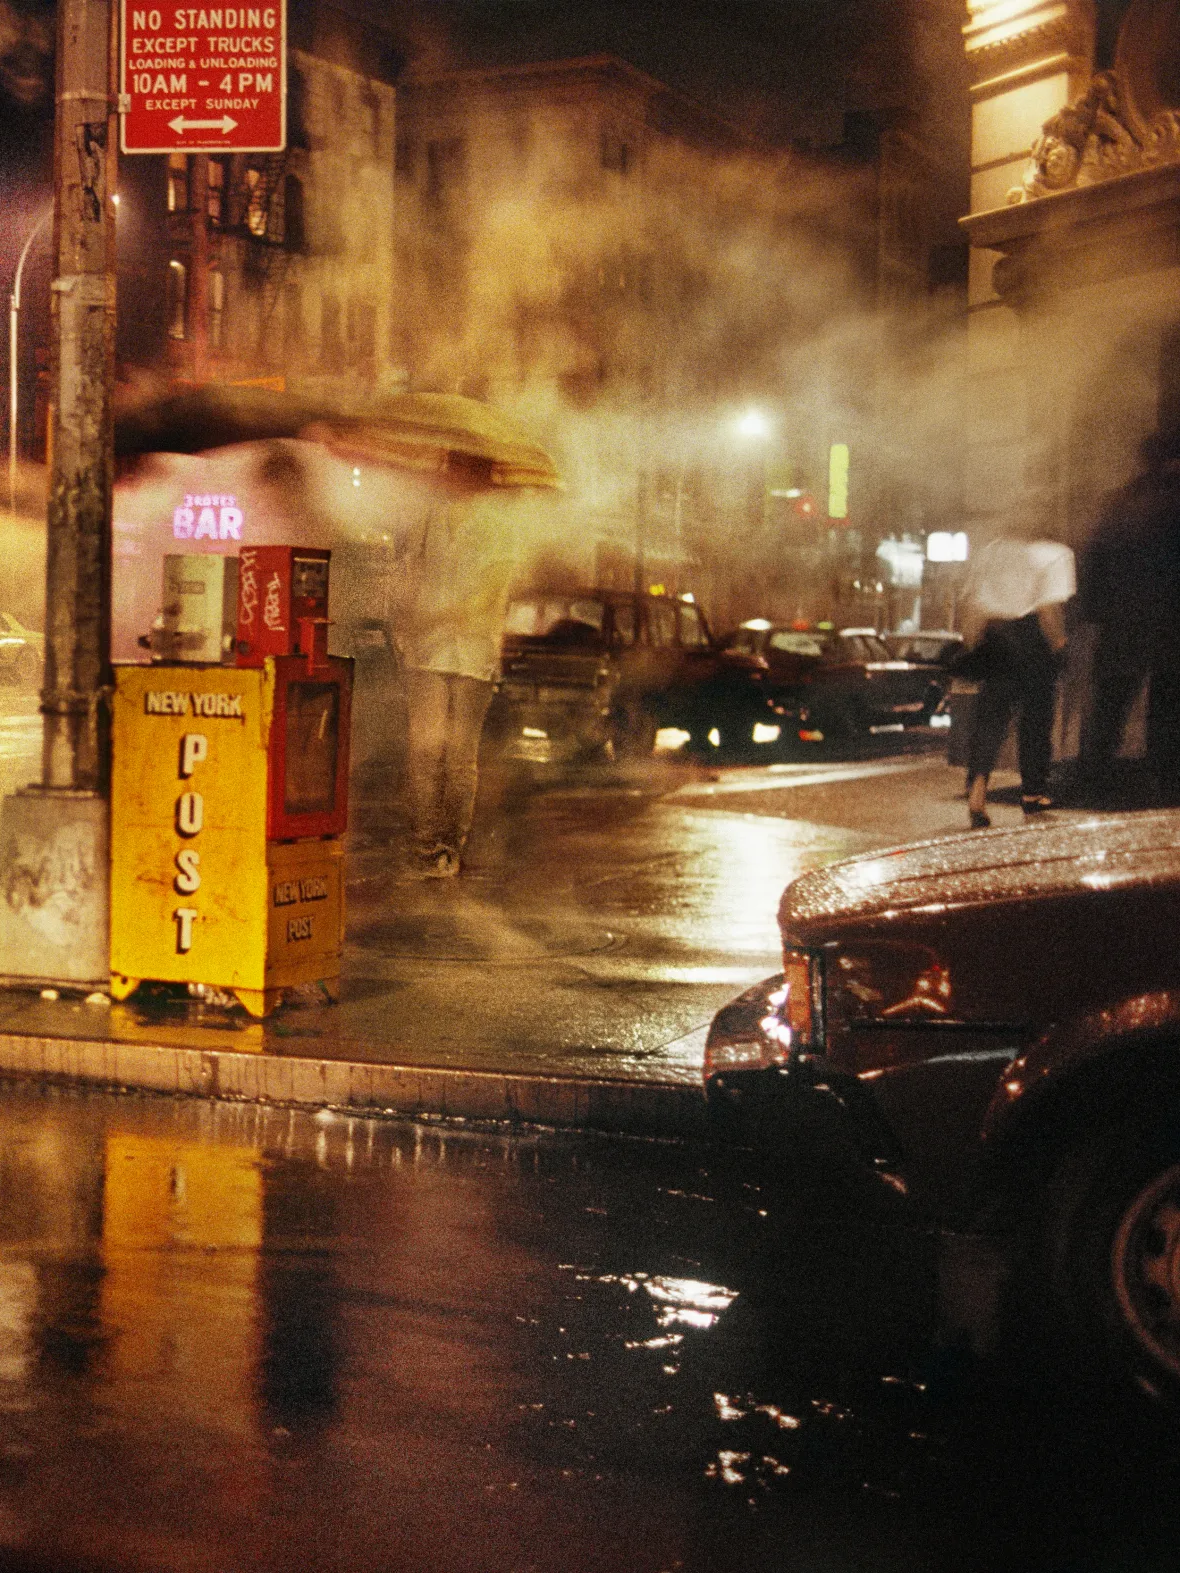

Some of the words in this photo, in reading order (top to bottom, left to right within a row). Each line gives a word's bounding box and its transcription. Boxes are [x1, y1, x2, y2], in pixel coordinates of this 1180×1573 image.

[133, 10, 161, 30] NO
[174, 8, 276, 30] STANDING
[132, 37, 198, 53] EXCEPT
[208, 36, 275, 53] TRUCKS
[129, 58, 186, 70] LOADING
[188, 59, 196, 69] &
[200, 57, 278, 69] UNLOADING
[133, 73, 187, 94] 10AM
[145, 99, 197, 111] EXCEPT
[205, 98, 260, 110] SUNDAY
[173, 506, 243, 540] BAR
[145, 691, 188, 715] NEW
[192, 693, 244, 720] YORK
[173, 733, 208, 955] POST
[274, 882, 298, 906] NEW
[299, 876, 328, 900] YORK
[287, 915, 315, 942] POST
